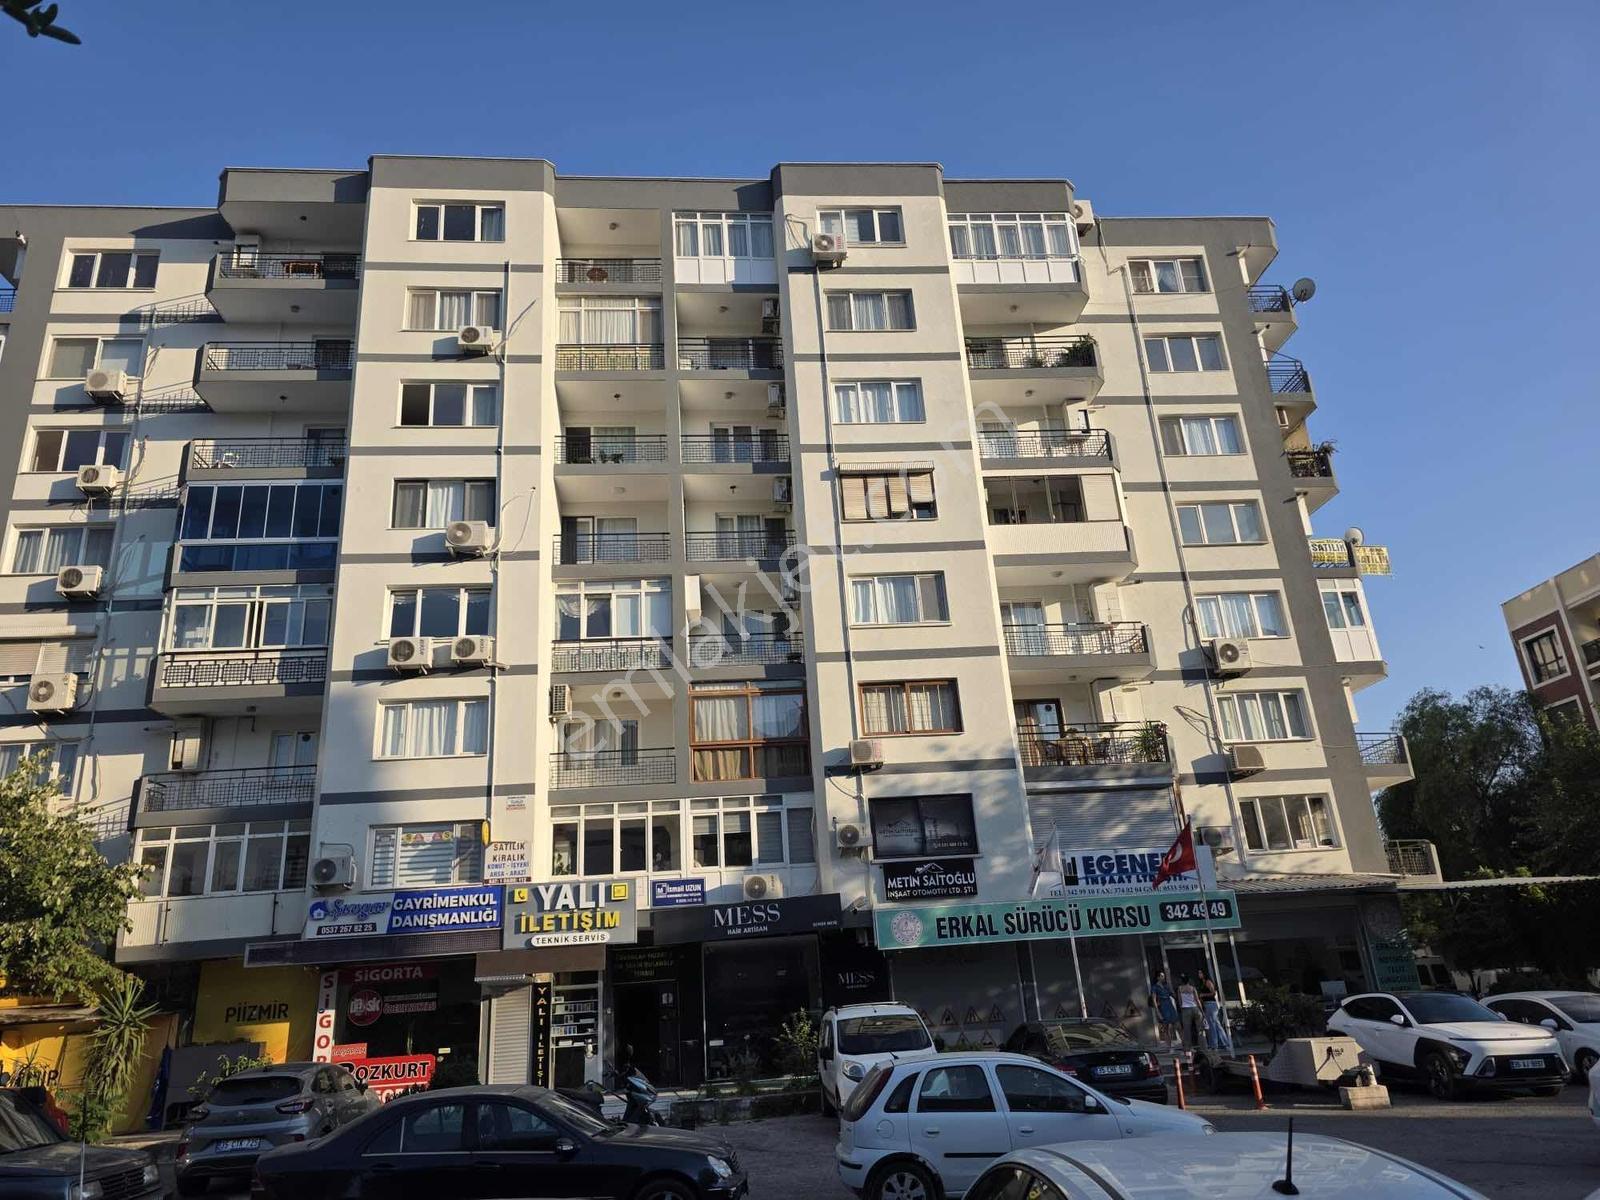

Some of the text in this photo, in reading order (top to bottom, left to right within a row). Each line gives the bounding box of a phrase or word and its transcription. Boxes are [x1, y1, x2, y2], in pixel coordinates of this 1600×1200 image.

[493, 842, 526, 851] SATILIK
[1081, 852, 1168, 876] EGENE
[393, 892, 498, 912] GAYRİMENKUL
[537, 882, 606, 911] YALI
[392, 908, 498, 928] DANIŞMANLIĞI
[520, 908, 621, 935] İLETİŞİM
[713, 902, 781, 928] MESS
[935, 903, 1152, 939] ERKAL SÜRÜCÜ KURSU
[1165, 904, 1190, 920] 342
[1210, 901, 1226, 917] 49
